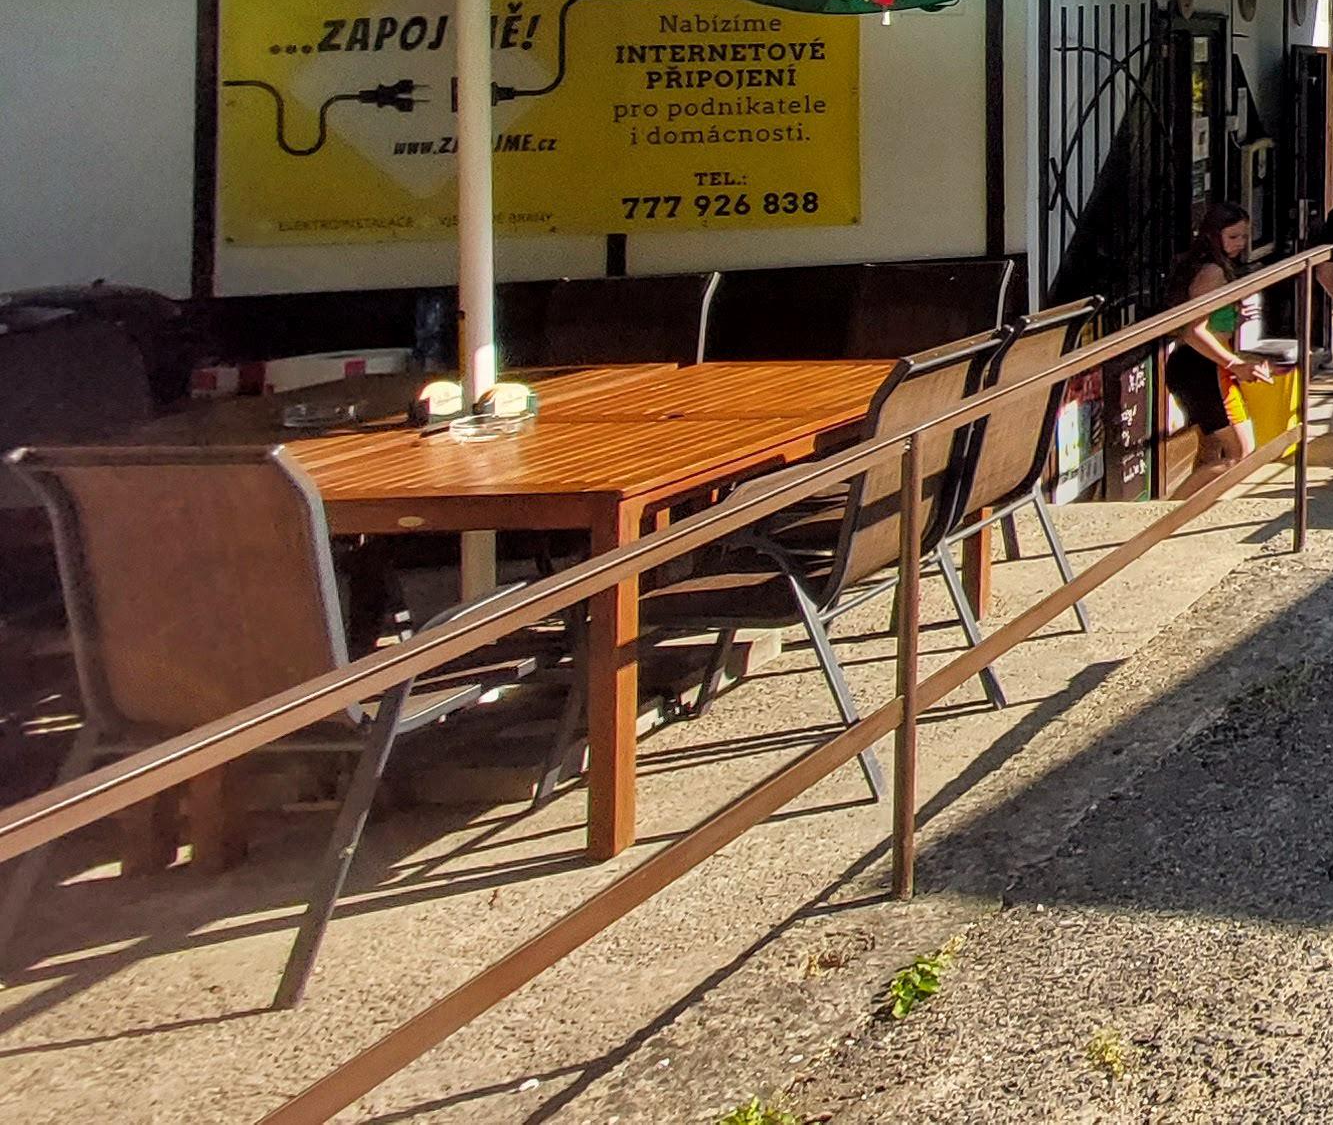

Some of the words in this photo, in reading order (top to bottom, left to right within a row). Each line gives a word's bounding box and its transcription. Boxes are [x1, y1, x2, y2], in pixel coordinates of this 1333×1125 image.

[659, 14, 782, 33] Nabízíme
[615, 38, 825, 64] INTERNETOVÉ
[646, 64, 796, 90] PŘIPOJENÍ
[613, 103, 658, 123] pro
[668, 95, 826, 121] podnikatele
[630, 127, 638, 145] i
[647, 123, 810, 145] domácnosti.
[694, 172, 748, 186] TEL.:
[622, 196, 682, 219] 777
[694, 194, 751, 217] 926
[763, 192, 819, 214] 838
